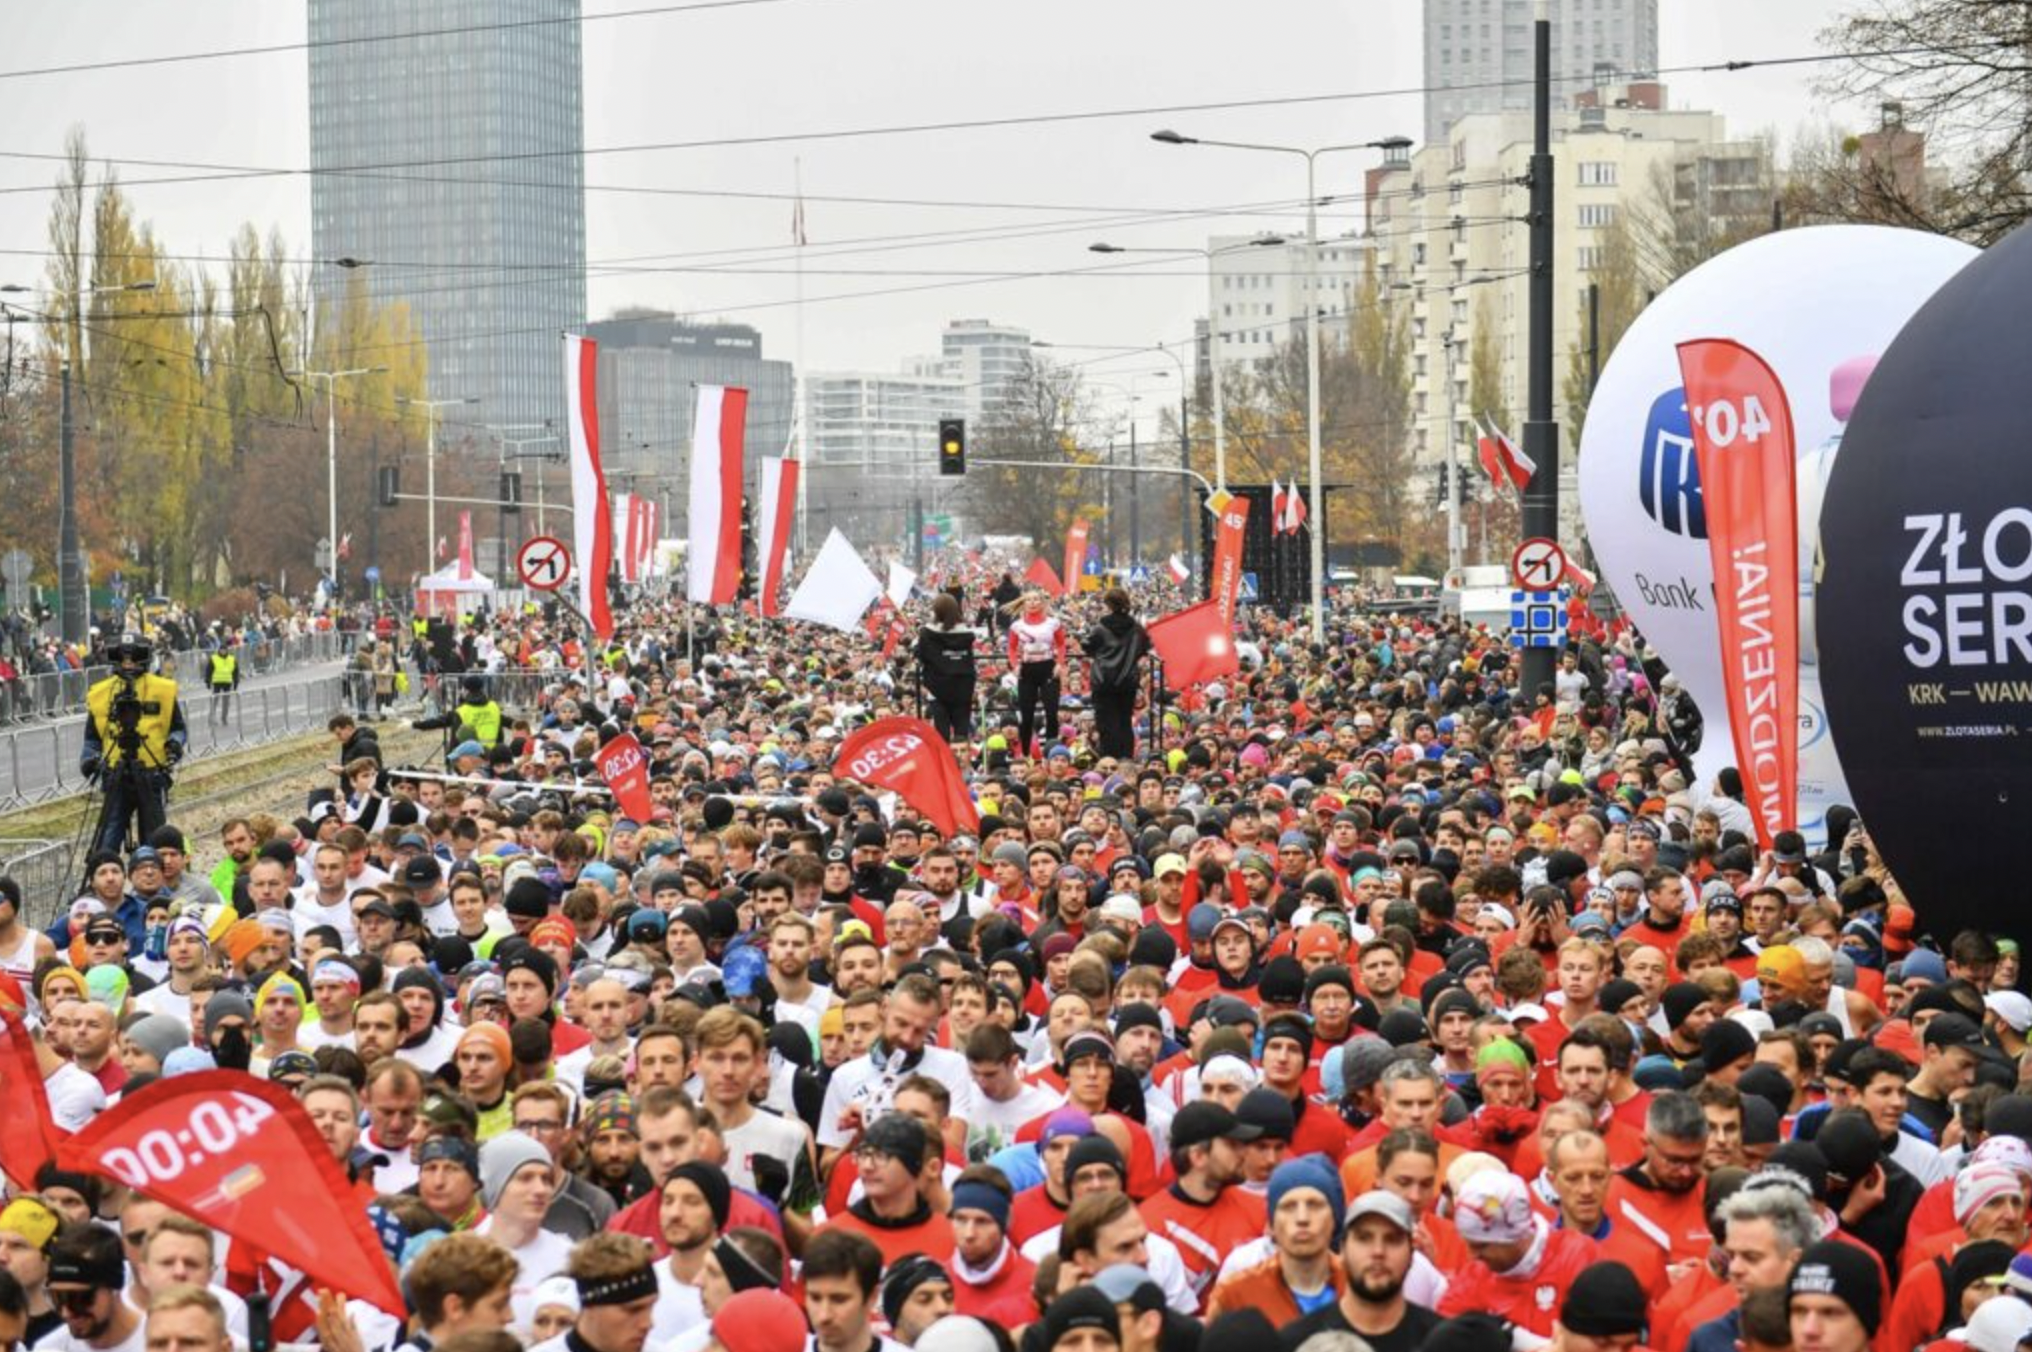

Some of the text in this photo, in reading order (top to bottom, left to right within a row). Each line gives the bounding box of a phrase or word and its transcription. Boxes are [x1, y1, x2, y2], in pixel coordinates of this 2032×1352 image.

[1900, 507, 2032, 586] ZŁO
[1635, 573, 1705, 611] Bank
[1902, 591, 2032, 668] SER
[1908, 683, 1947, 704] KRK
[1974, 681, 2032, 702] WAW
